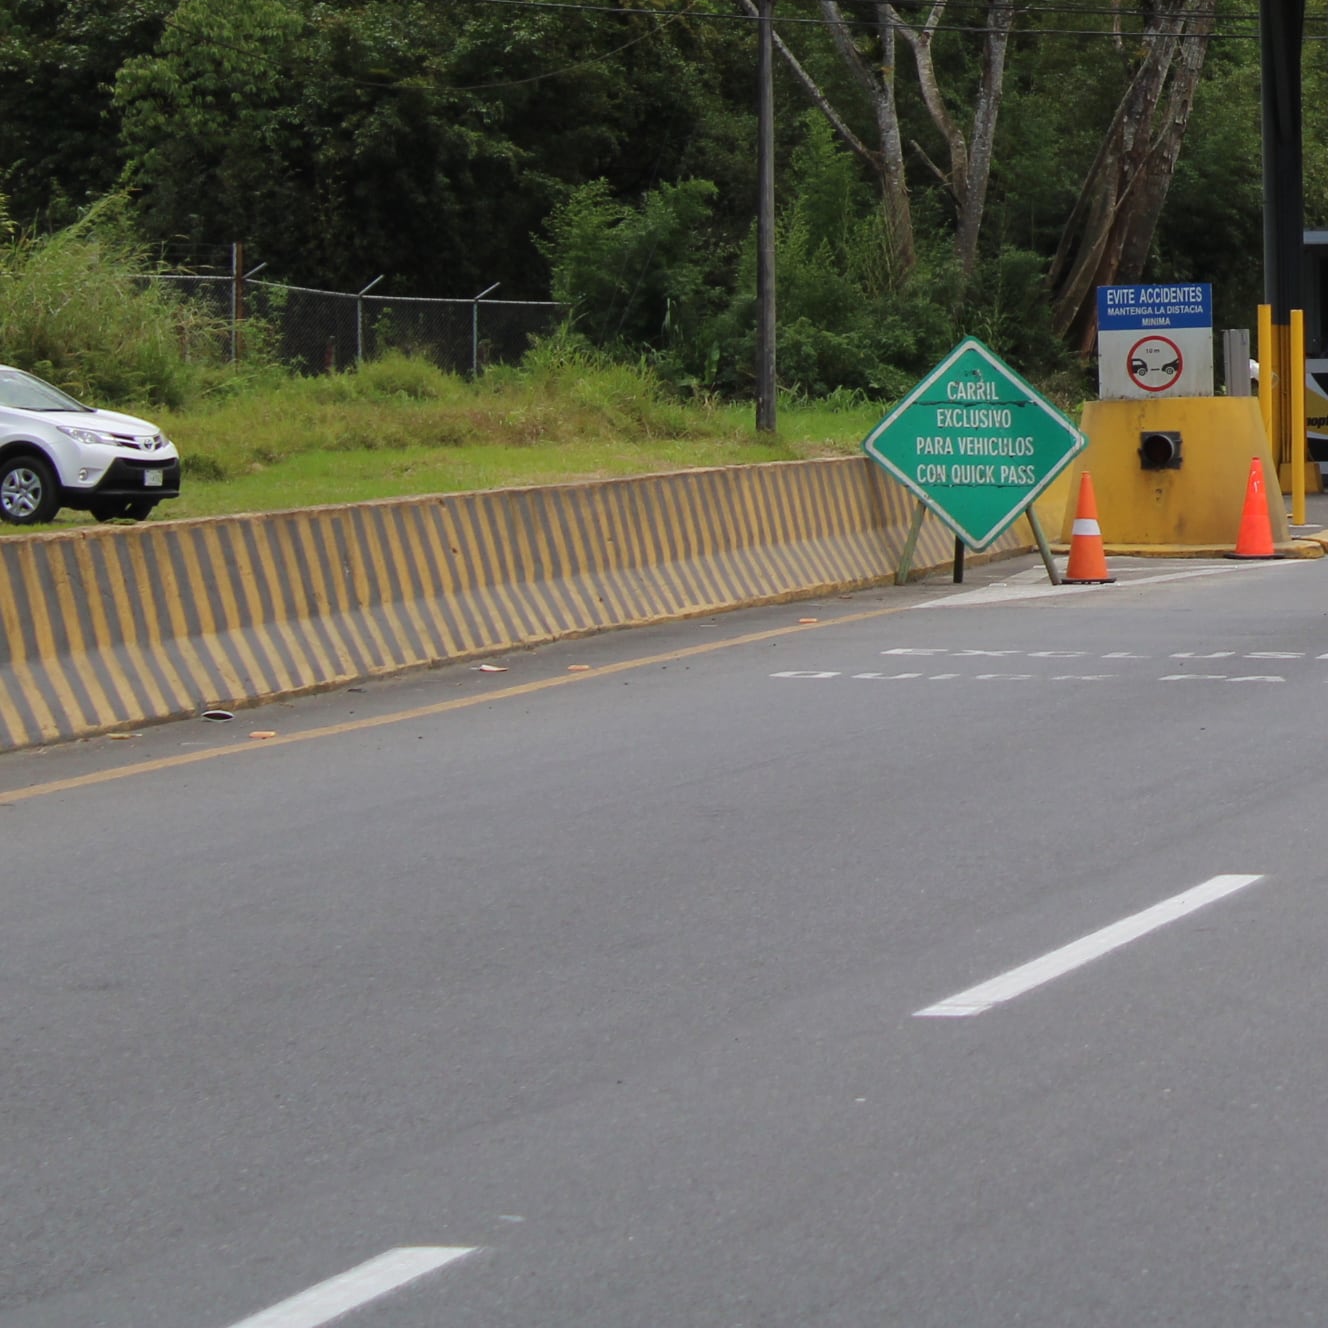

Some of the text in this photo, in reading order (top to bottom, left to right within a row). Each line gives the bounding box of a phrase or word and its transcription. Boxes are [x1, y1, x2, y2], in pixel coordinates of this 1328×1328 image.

[1107, 286, 1203, 305] EVITE ACCIDENTES
[1107, 304, 1204, 316] MANTENGA LA DISTACIA
[1142, 317, 1171, 327] MINIMA
[947, 380, 999, 400] CARRIL
[936, 408, 1012, 428] EXCLUSIVO
[916, 436, 1034, 456] PARA VEHICULOS
[916, 464, 1036, 485] CON QUICK PASS
